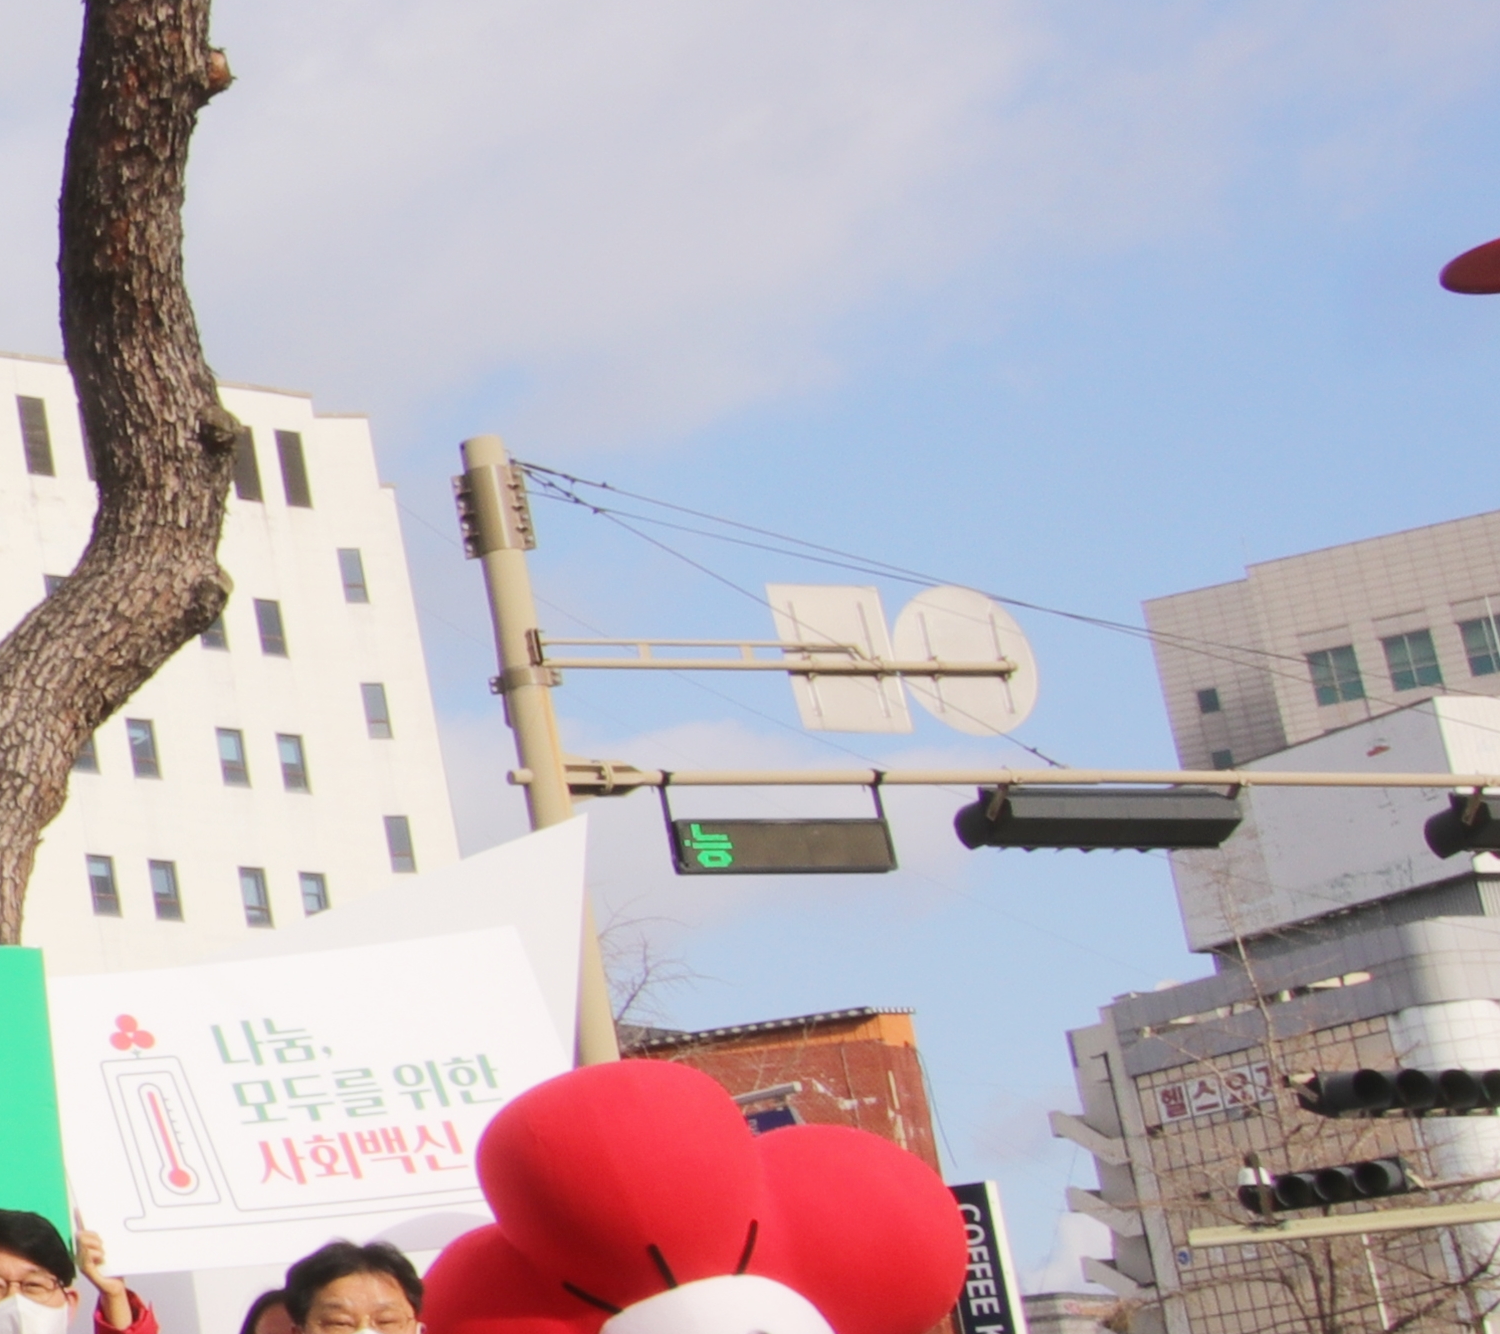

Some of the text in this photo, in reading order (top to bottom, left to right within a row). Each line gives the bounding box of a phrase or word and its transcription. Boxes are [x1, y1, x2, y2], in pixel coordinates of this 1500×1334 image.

[209, 1017, 333, 1067] 나눔,
[231, 1053, 503, 1125] 모두를 위한
[257, 1119, 470, 1186] 사회백신
[957, 1203, 1000, 1317] COFFEE
